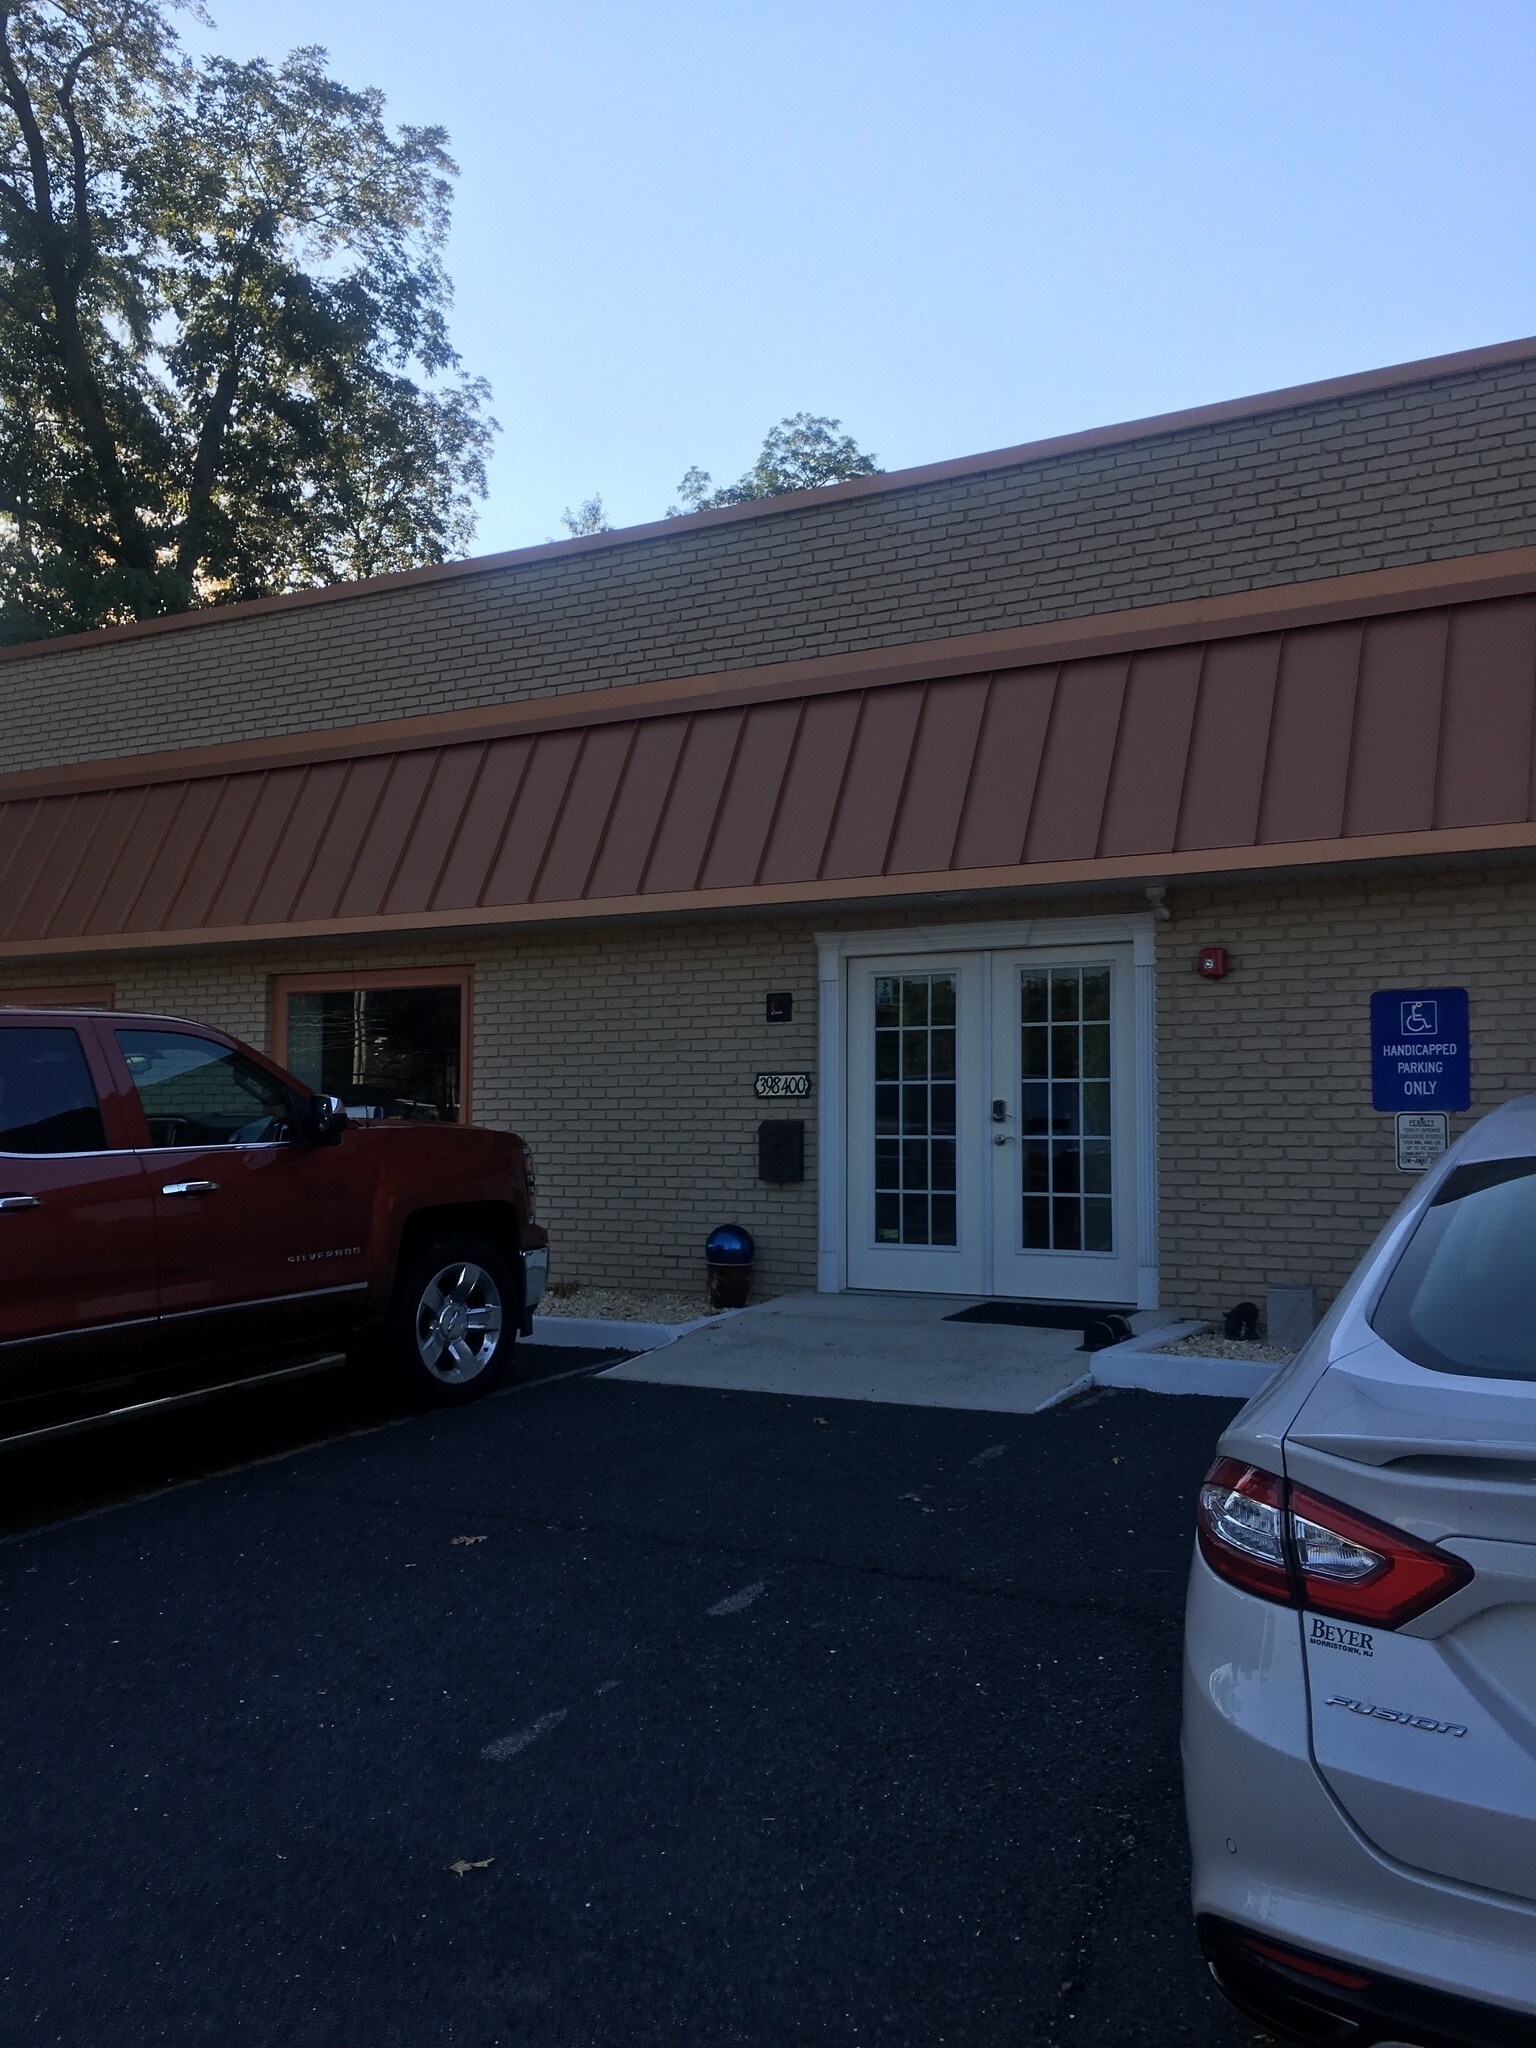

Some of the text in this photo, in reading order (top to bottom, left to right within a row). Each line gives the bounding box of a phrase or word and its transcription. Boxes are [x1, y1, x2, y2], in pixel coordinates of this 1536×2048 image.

[1383, 1044, 1457, 1056] HANDICAPPED
[1398, 1062, 1443, 1073] PARKING
[759, 1076, 806, 1095] 398400
[1404, 1081, 1437, 1095] ONLY
[287, 1247, 360, 1262] SILVERADO
[1310, 1618, 1373, 1650] BEYER
[1309, 1637, 1361, 1656] MORRISTOWN,
[1324, 1694, 1468, 1738] FUSION
